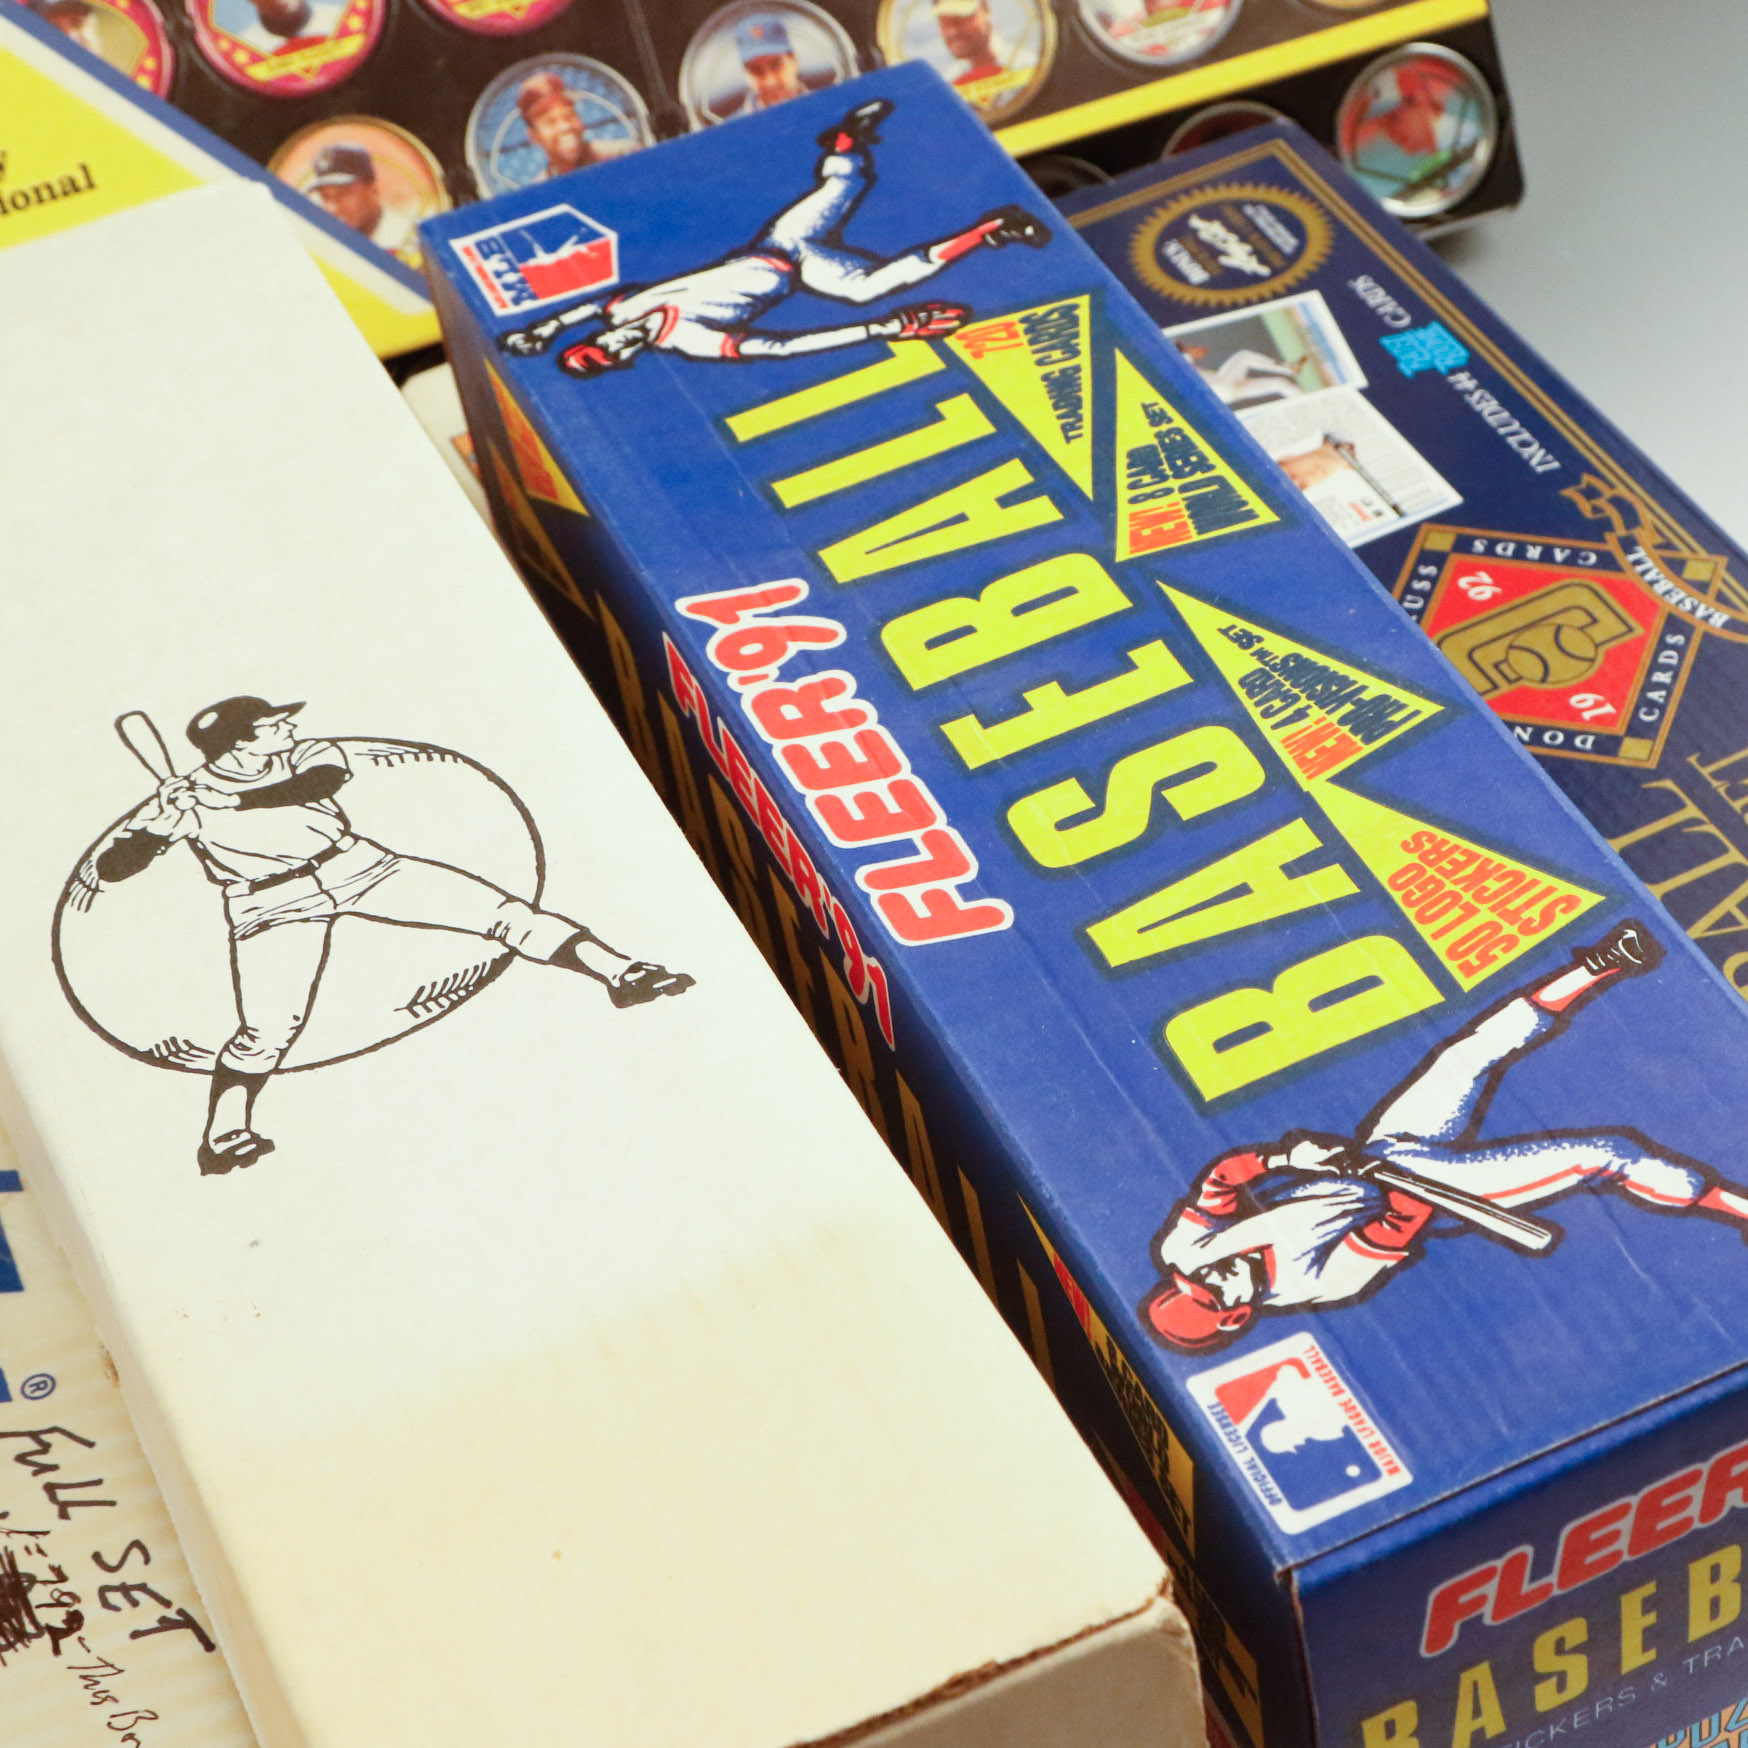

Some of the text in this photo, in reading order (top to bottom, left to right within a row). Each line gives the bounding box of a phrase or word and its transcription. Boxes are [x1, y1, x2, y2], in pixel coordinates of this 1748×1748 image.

[1347, 274, 1412, 329] CARDS
[1022, 303, 1084, 444] TRADING CARDS
[1141, 401, 1175, 428] SET
[1154, 427, 1217, 481] SERIES
[1463, 387, 1562, 474] INCLUDES
[1126, 444, 1198, 556] NEW! 8 CARD
[1402, 564, 1438, 622] USS
[1471, 538, 1598, 566] CARDS
[1626, 545, 1732, 629] BASEBALL
[1217, 623, 1266, 652] SET
[1638, 633, 1686, 722] CARDS
[724, 340, 1445, 1102] BASEBALL
[1237, 667, 1302, 720] CARD
[1280, 715, 1364, 781] NEW!
[1389, 860, 1521, 980] 50 LOGO
[1400, 829, 1583, 938] STICKERS
[1305, 1345, 1402, 1477] MAJOR LEAGUE BASEBALL
[1242, 1453, 1285, 1506] OFFICIAL
[91, 1538, 216, 1653] SET
[1361, 1545, 1742, 1748] BASEB
[1651, 1673, 1668, 1692] &
[1683, 1637, 1744, 1675] TRA
